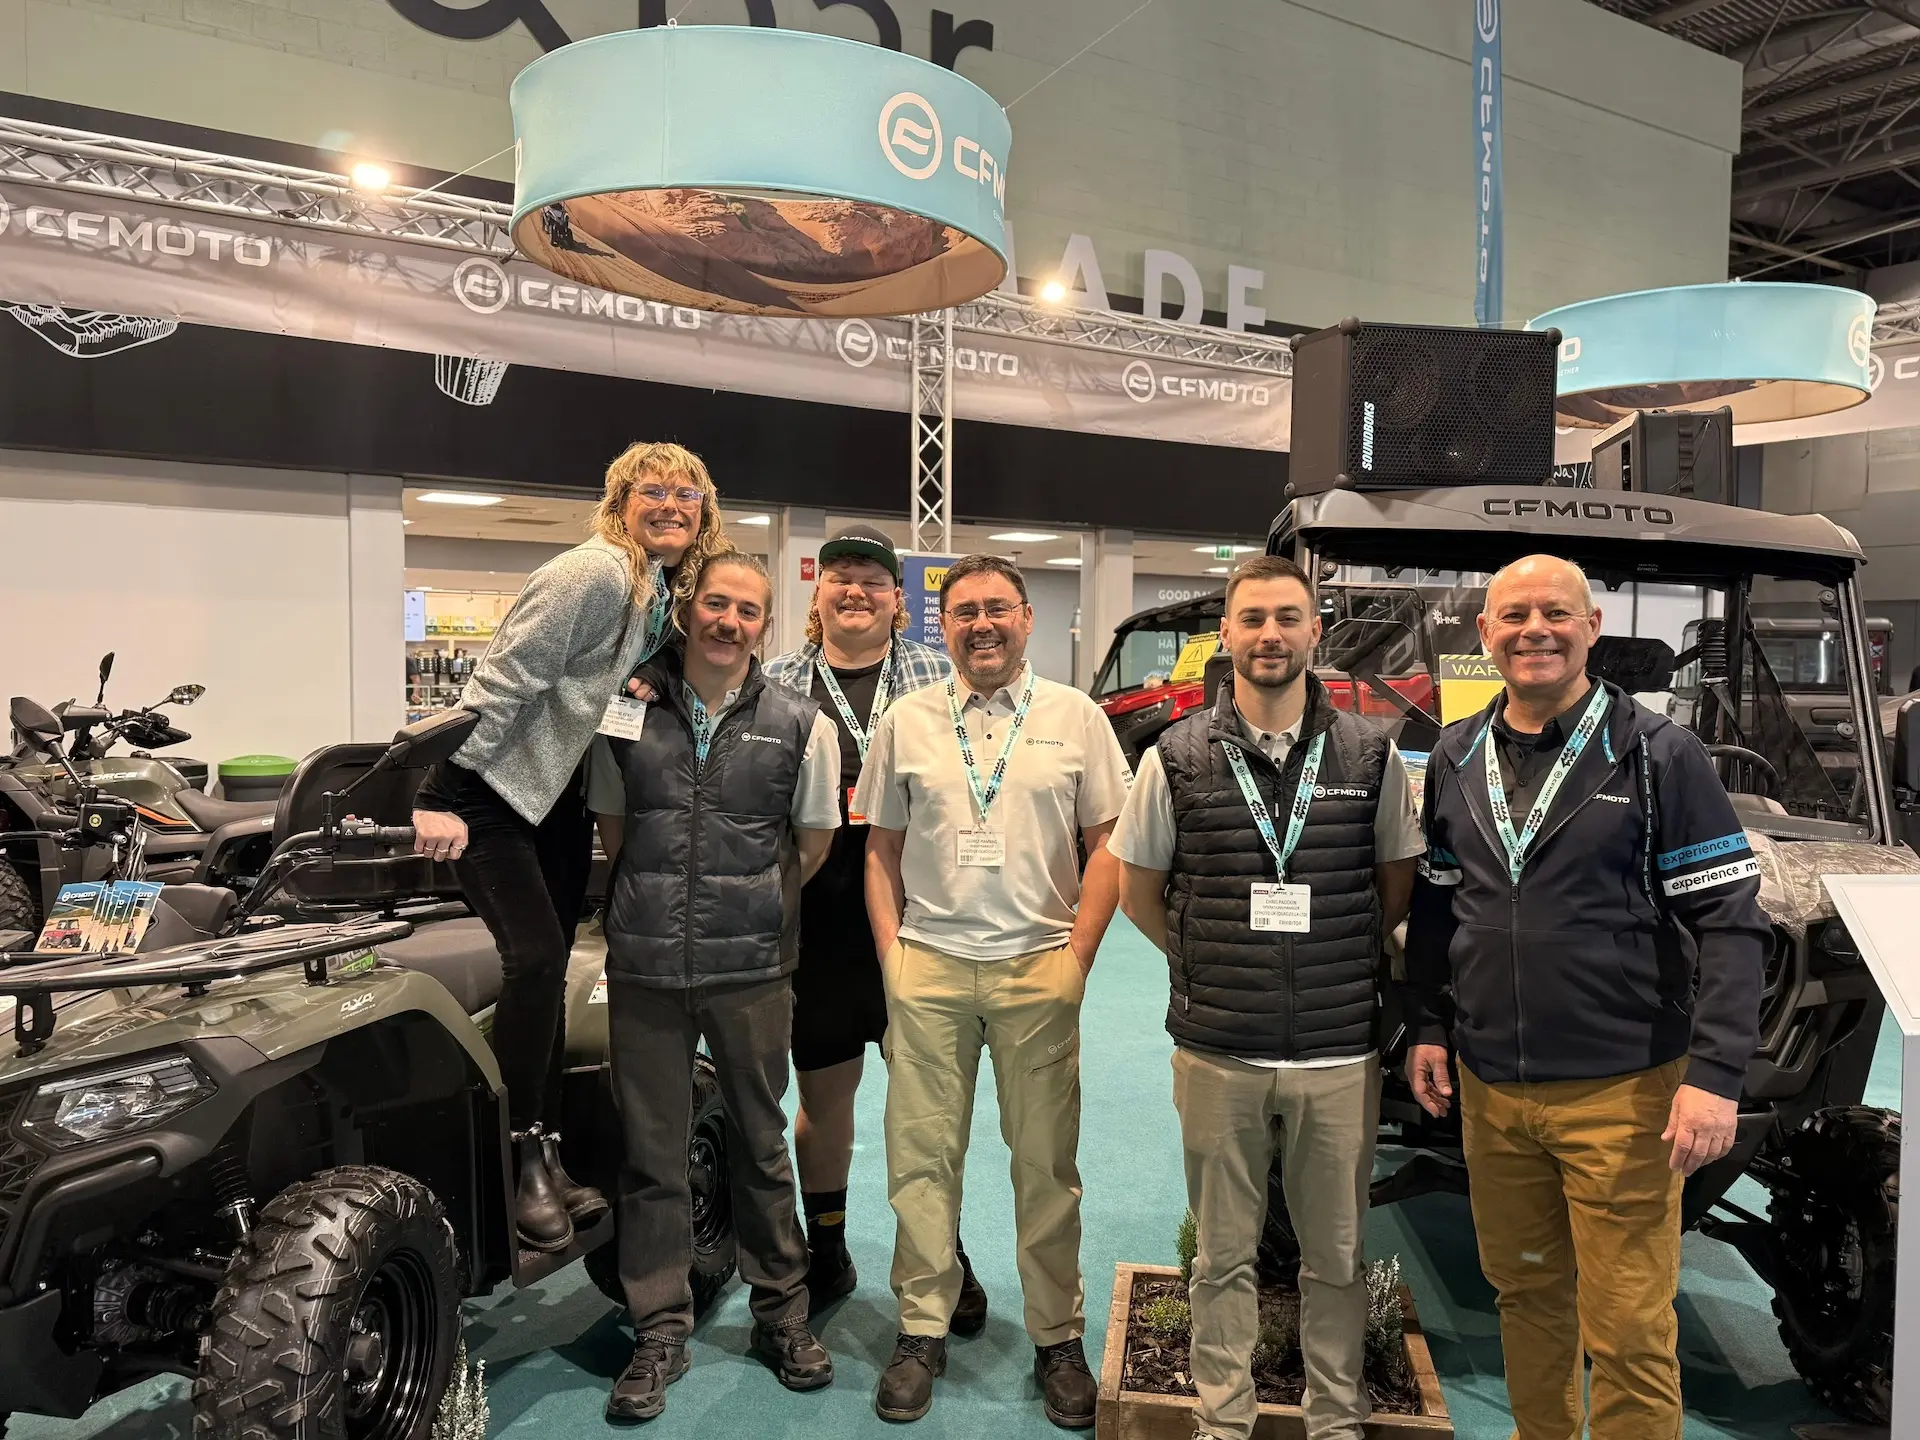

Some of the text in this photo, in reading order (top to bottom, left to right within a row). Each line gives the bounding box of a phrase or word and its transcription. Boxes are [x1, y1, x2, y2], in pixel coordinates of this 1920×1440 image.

[25, 205, 271, 267] CFMOTO
[520, 279, 700, 330] CFMOTO
[1161, 376, 1269, 406] CFMOTO
[1362, 401, 1375, 471] SOUNDBOKS
[1483, 498, 1675, 525] CFMOTO
[1158, 589, 1191, 601] GOOD
[924, 626, 939, 634] FOR
[752, 734, 782, 745] CFMOTO
[1035, 739, 1064, 747] CFMOTO
[1327, 788, 1368, 798] CFMOTO
[1592, 793, 1631, 804] FMOTO
[1662, 839, 1730, 864] experience
[1671, 866, 1739, 890] experience
